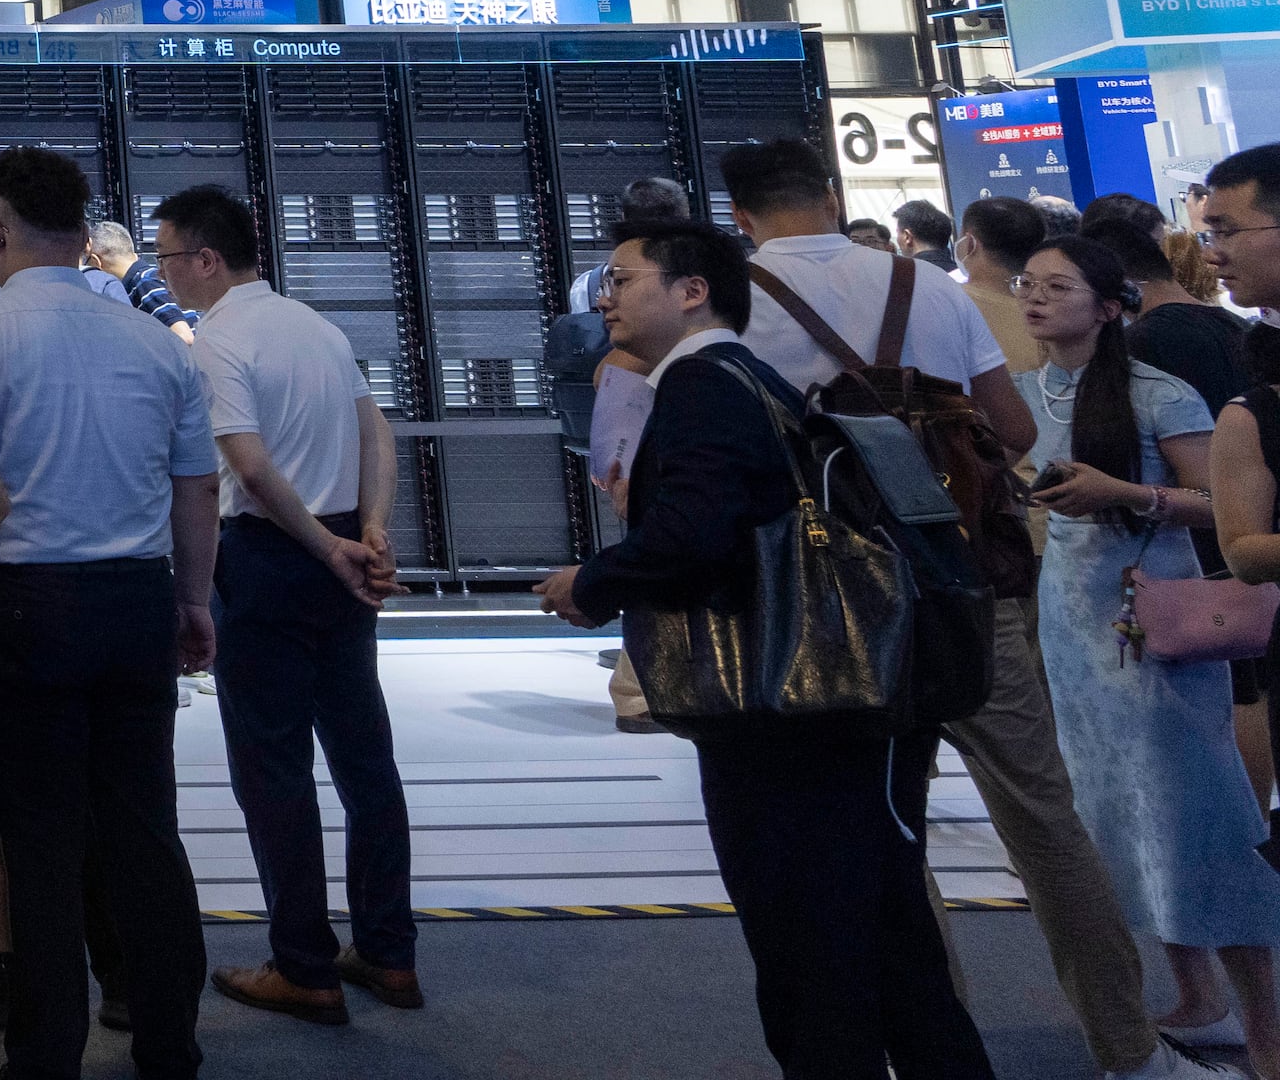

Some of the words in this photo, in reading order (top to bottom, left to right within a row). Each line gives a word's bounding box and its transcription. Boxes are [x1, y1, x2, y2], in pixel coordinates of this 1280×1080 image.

[213, 0, 264, 9] 黑芝麻智能
[1142, 0, 1179, 12] BYD
[158, 38, 234, 57] 计算柜
[253, 38, 340, 59] Compute
[1097, 80, 1118, 88] BYD
[1119, 78, 1147, 87] Smart
[1101, 96, 1152, 107] 以车为核心
[945, 104, 979, 121] MEIG
